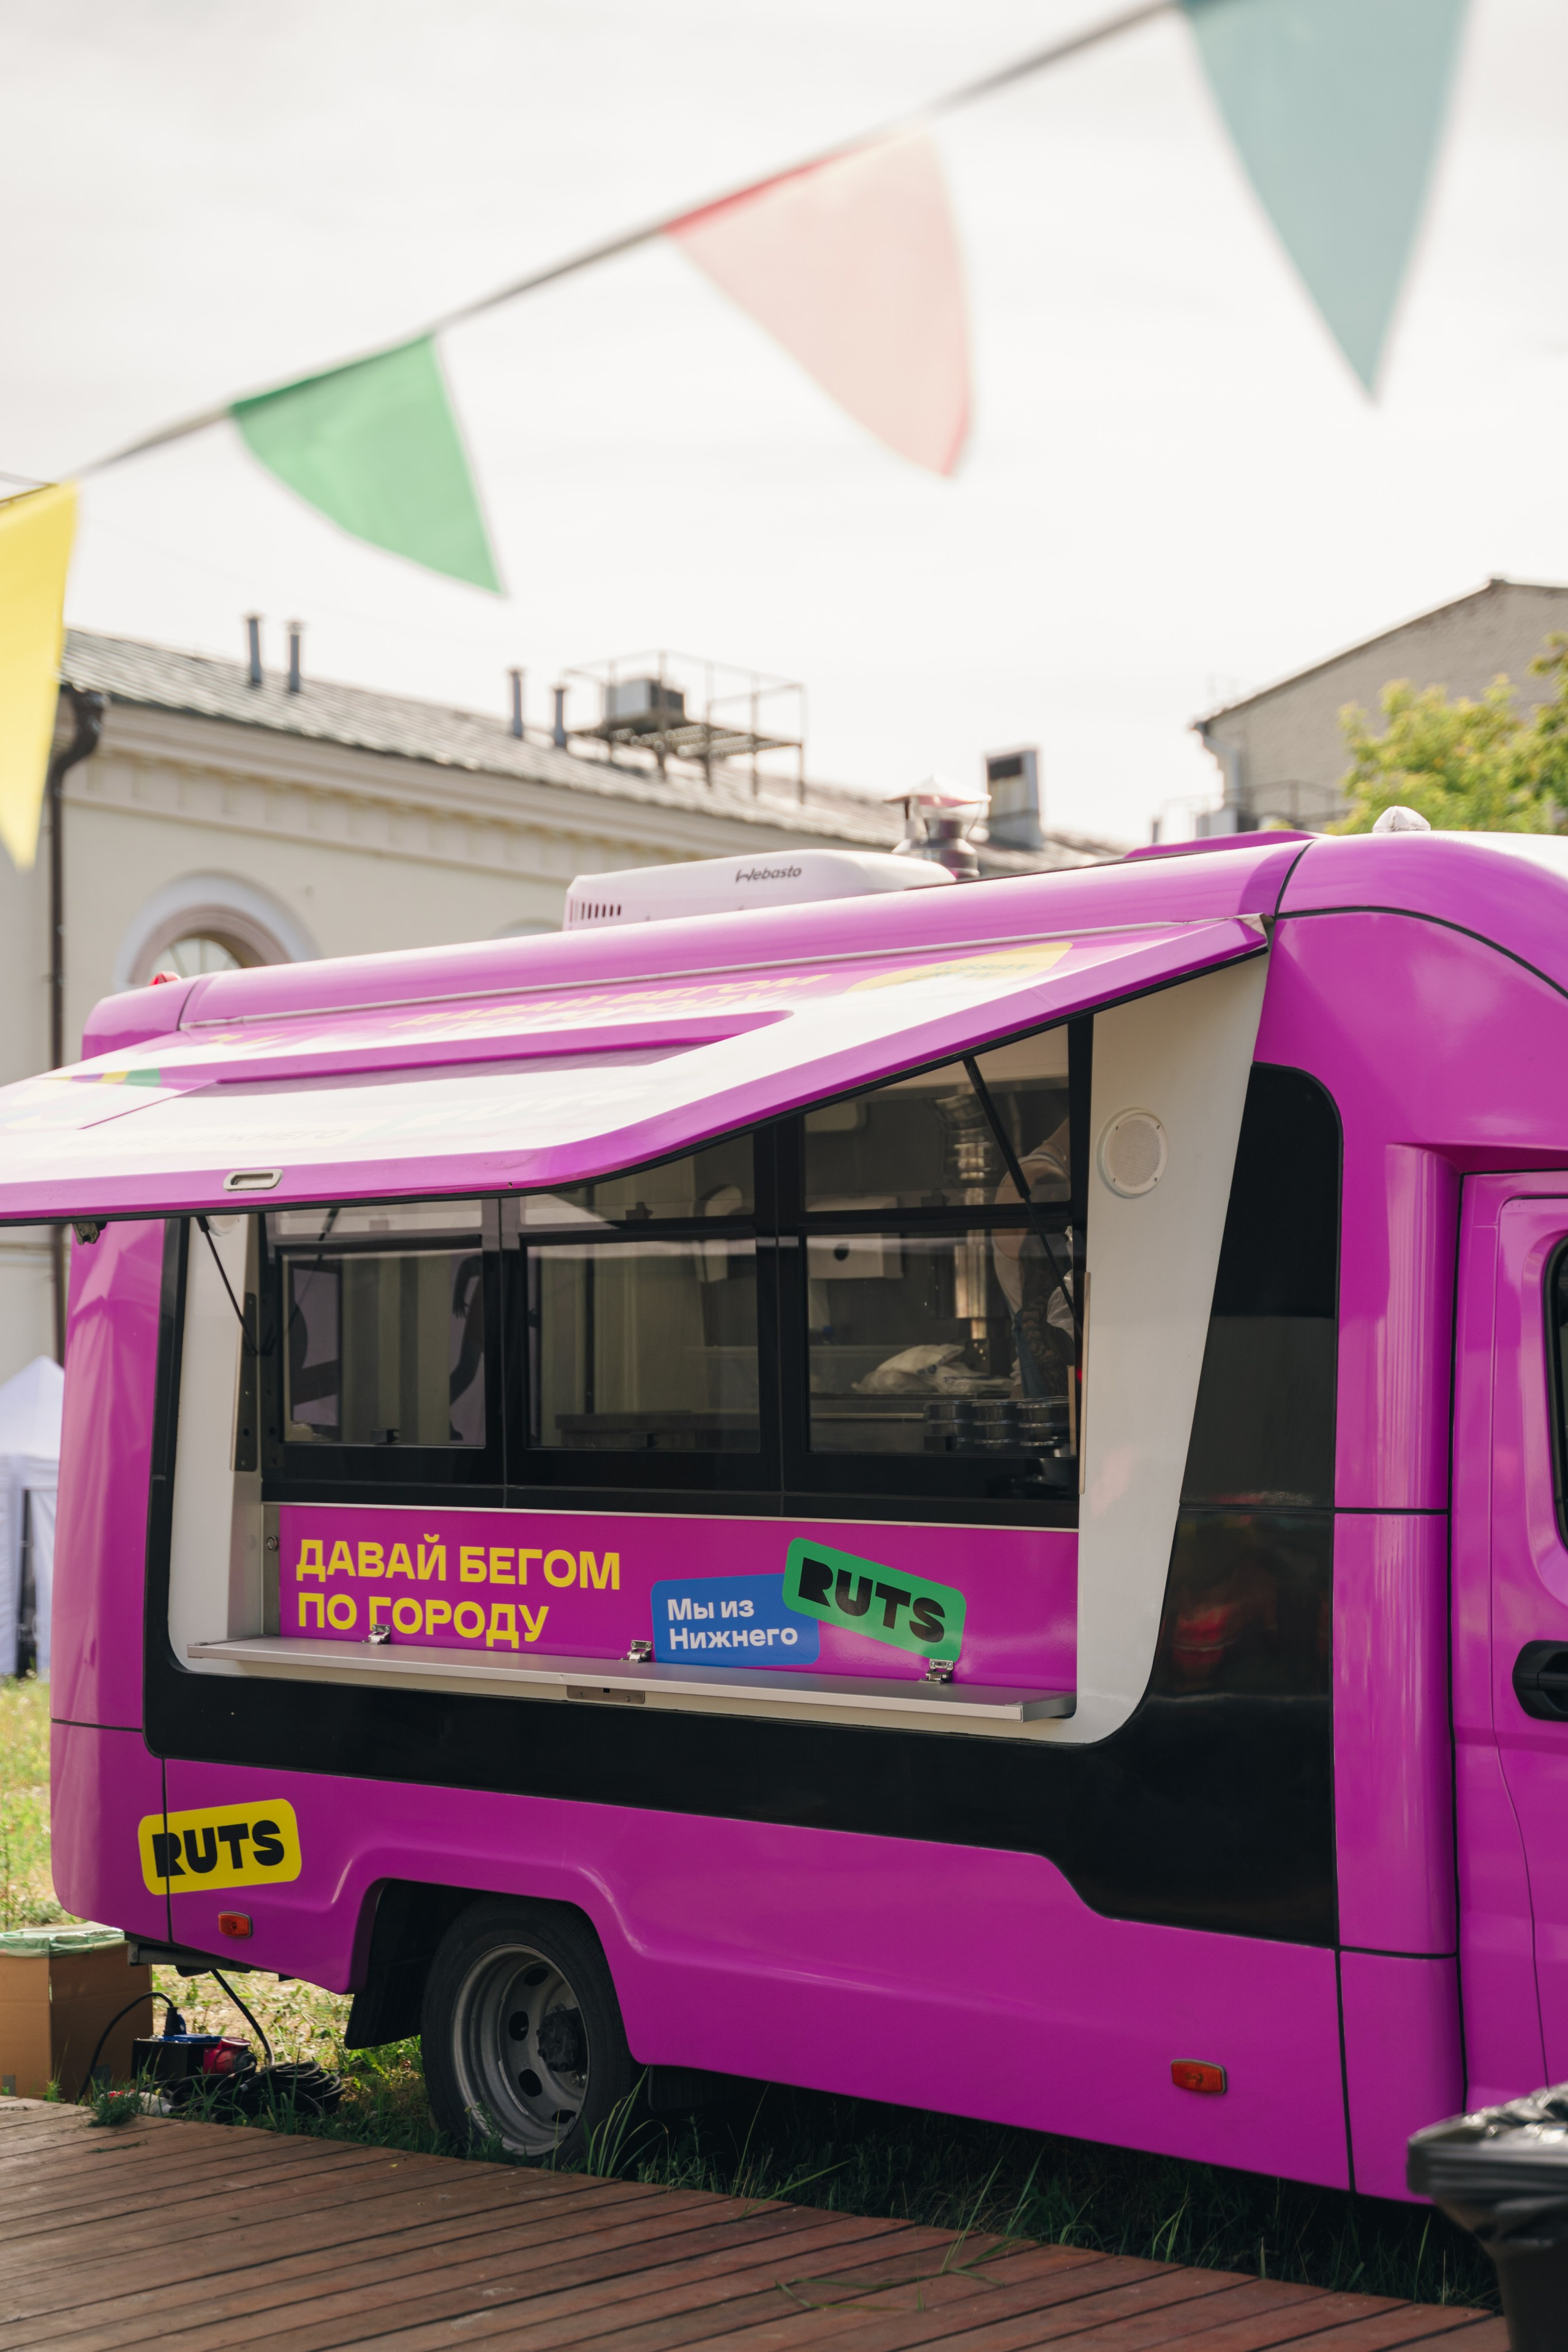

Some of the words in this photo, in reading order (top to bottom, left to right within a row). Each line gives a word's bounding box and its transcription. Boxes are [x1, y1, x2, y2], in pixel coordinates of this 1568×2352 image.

[735, 864, 802, 883] Webasto
[603, 973, 833, 1005] БЕГОМ
[296, 1533, 447, 1582] ДАВАЙ
[459, 1545, 620, 1590] БЕГОМ
[298, 1592, 358, 1630] ПО
[369, 1596, 549, 1649] ГОРОДУ
[667, 1598, 714, 1621] Мы
[720, 1599, 755, 1618] из
[797, 1556, 946, 1643] RUTS
[669, 1627, 798, 1650] Нижнего
[151, 1819, 285, 1878] RUTS
